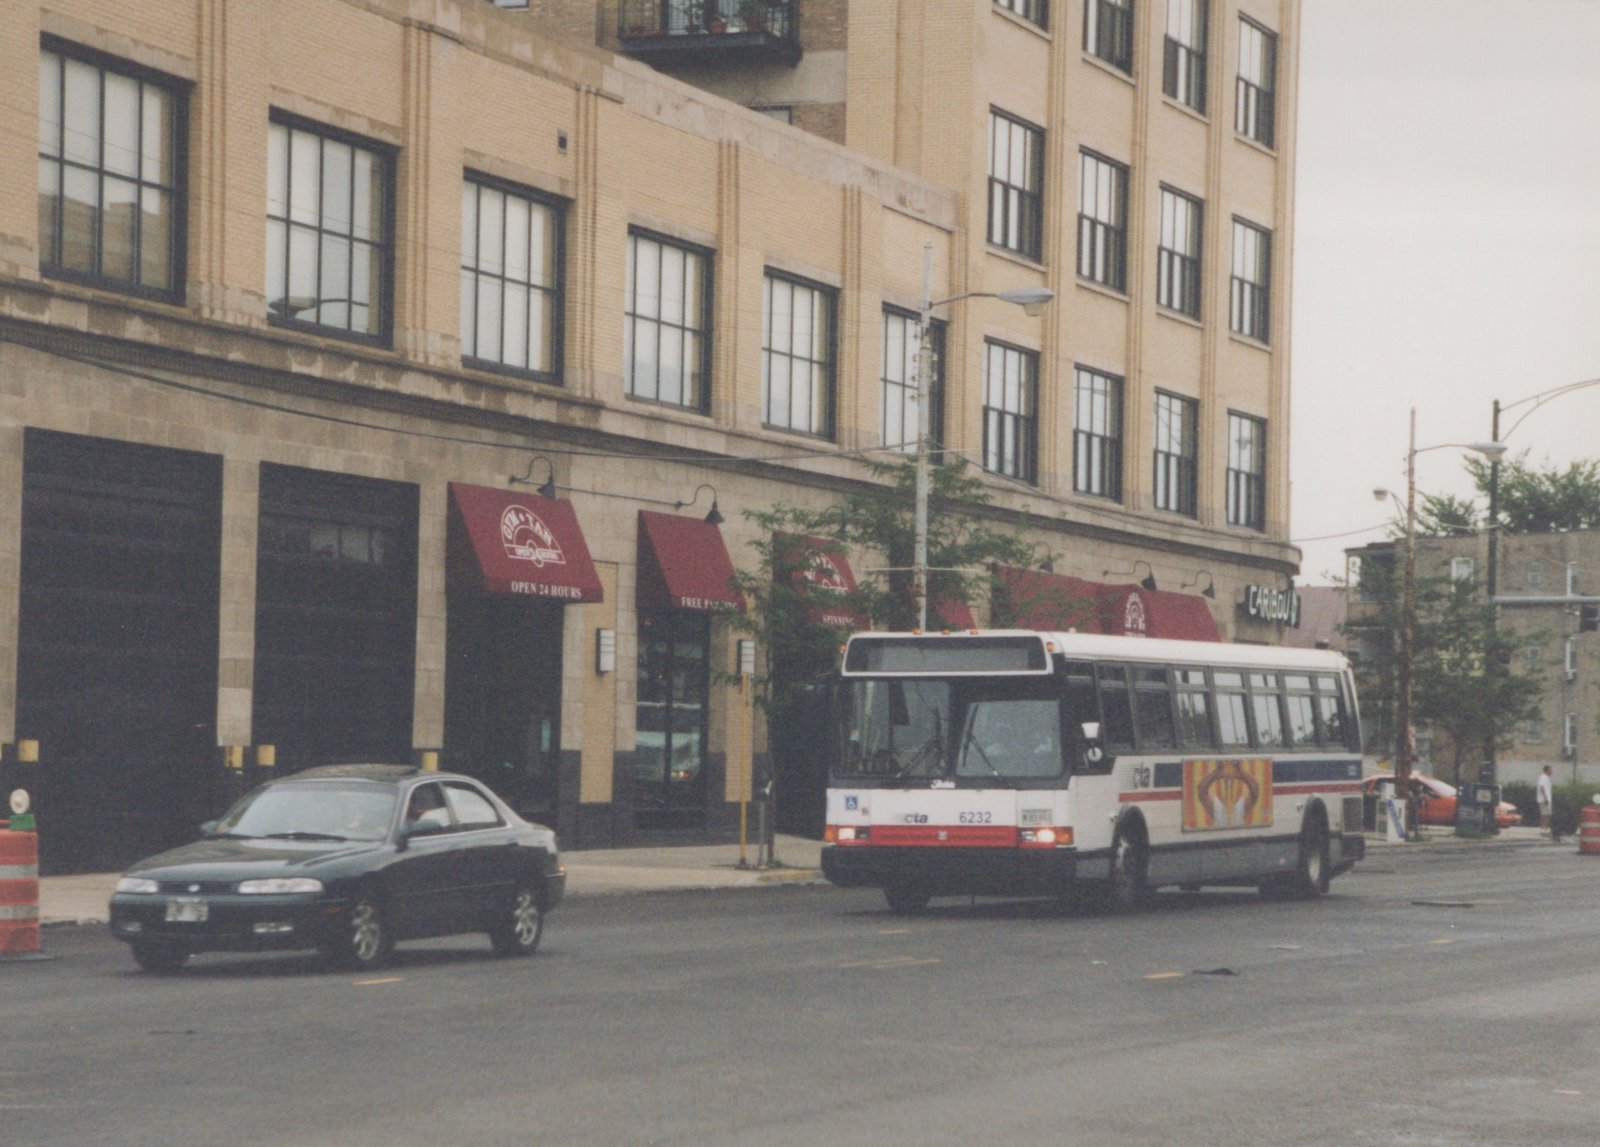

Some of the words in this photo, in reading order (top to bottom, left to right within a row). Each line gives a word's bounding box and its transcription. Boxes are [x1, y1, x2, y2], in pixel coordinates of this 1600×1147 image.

[525, 513, 552, 548] TAN
[511, 581, 536, 593] OPEN
[540, 584, 549, 595] 24
[551, 585, 582, 598] HOURS
[681, 596, 702, 609] FREE
[1249, 585, 1290, 621] CARIBOU
[904, 812, 929, 824] cta
[959, 811, 993, 824] 6232
